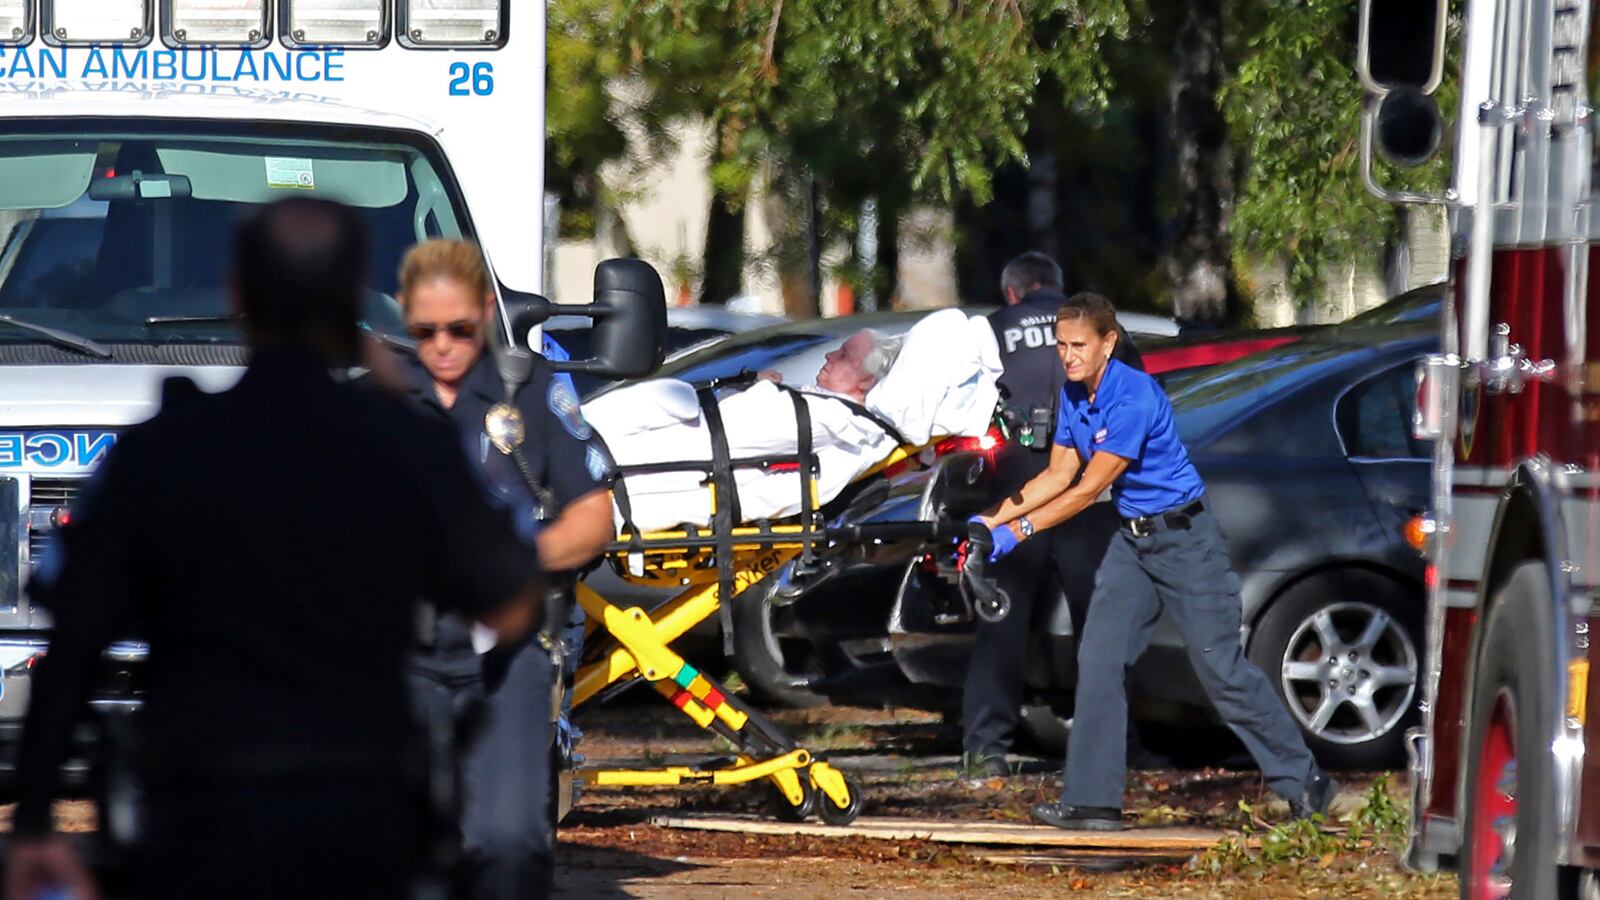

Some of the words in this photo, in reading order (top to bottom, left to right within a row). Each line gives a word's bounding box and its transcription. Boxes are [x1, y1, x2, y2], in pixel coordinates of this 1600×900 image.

[0, 43, 67, 79] AN
[81, 43, 345, 82] AMBULANCE
[449, 62, 494, 96] 26
[1020, 314, 1057, 327] HOLLY
